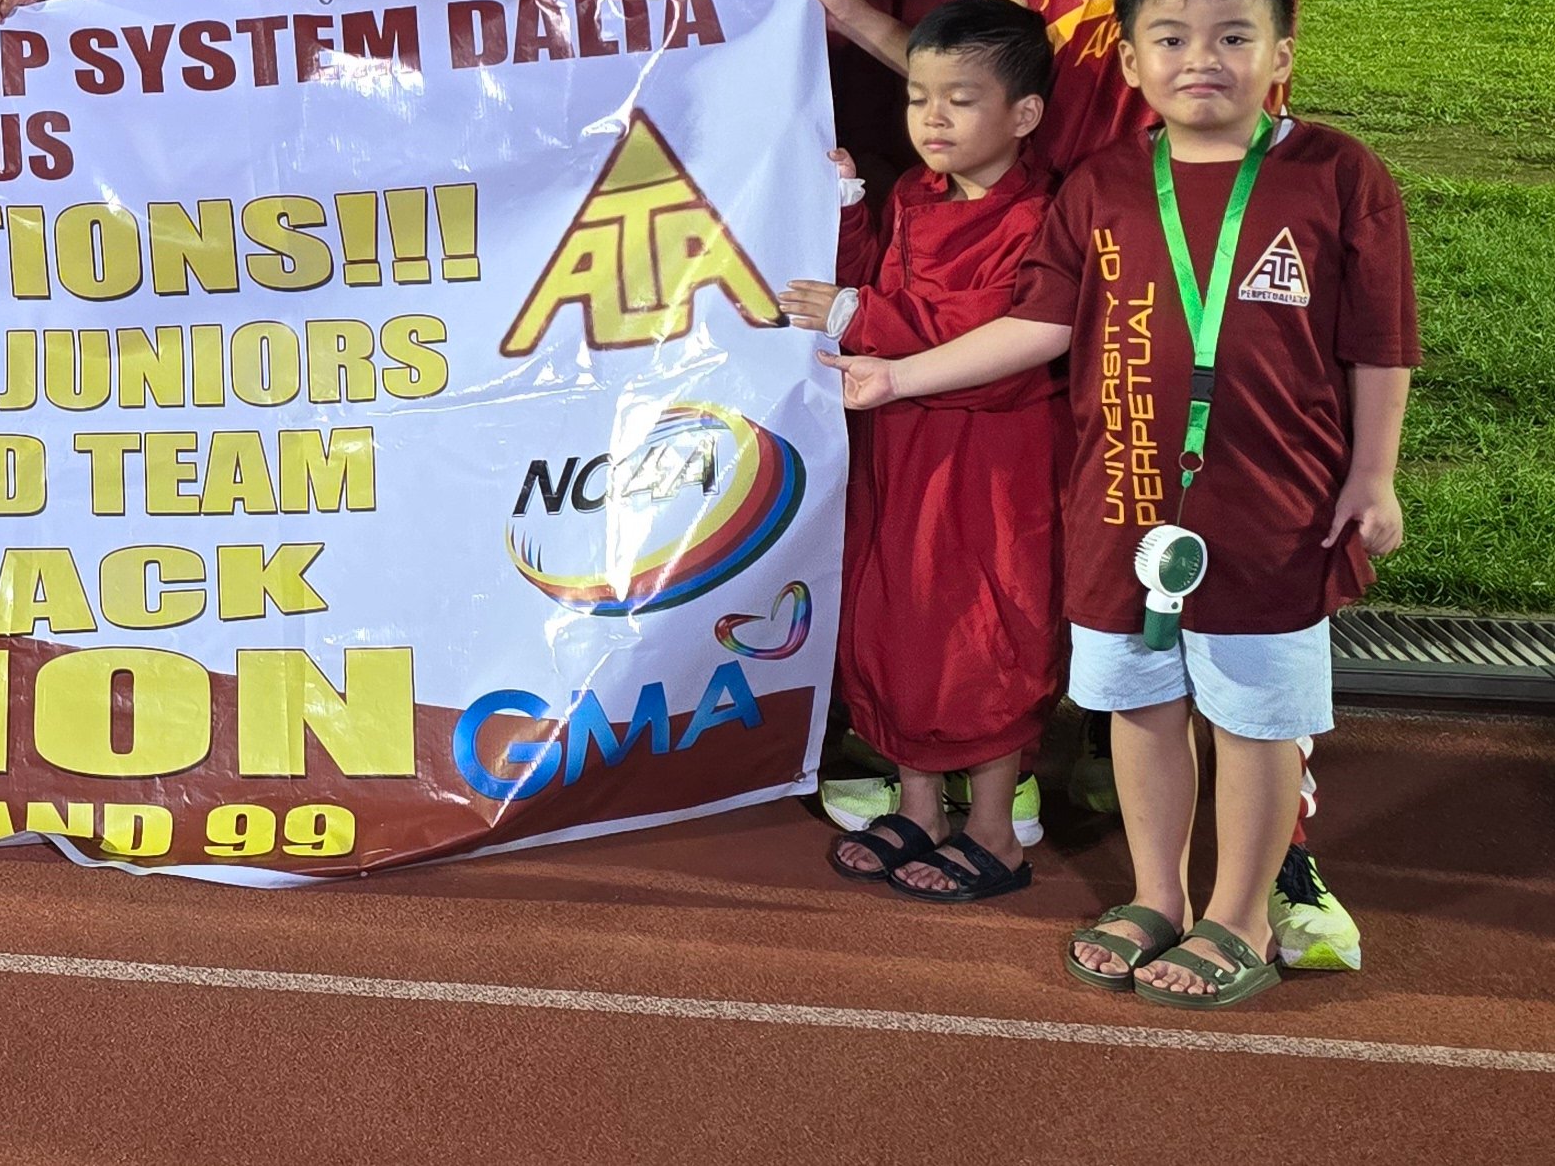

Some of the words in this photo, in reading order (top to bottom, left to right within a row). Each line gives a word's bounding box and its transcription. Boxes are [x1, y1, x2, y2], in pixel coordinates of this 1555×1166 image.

[70, 6, 423, 96] SYSTEM
[1094, 228, 1121, 281] OF
[1101, 291, 1126, 526] UNIVERSITY
[1128, 282, 1166, 527] PERPETUAL
[75, 426, 377, 516] TEAM
[452, 659, 764, 802] GMA
[205, 803, 356, 858] 99
